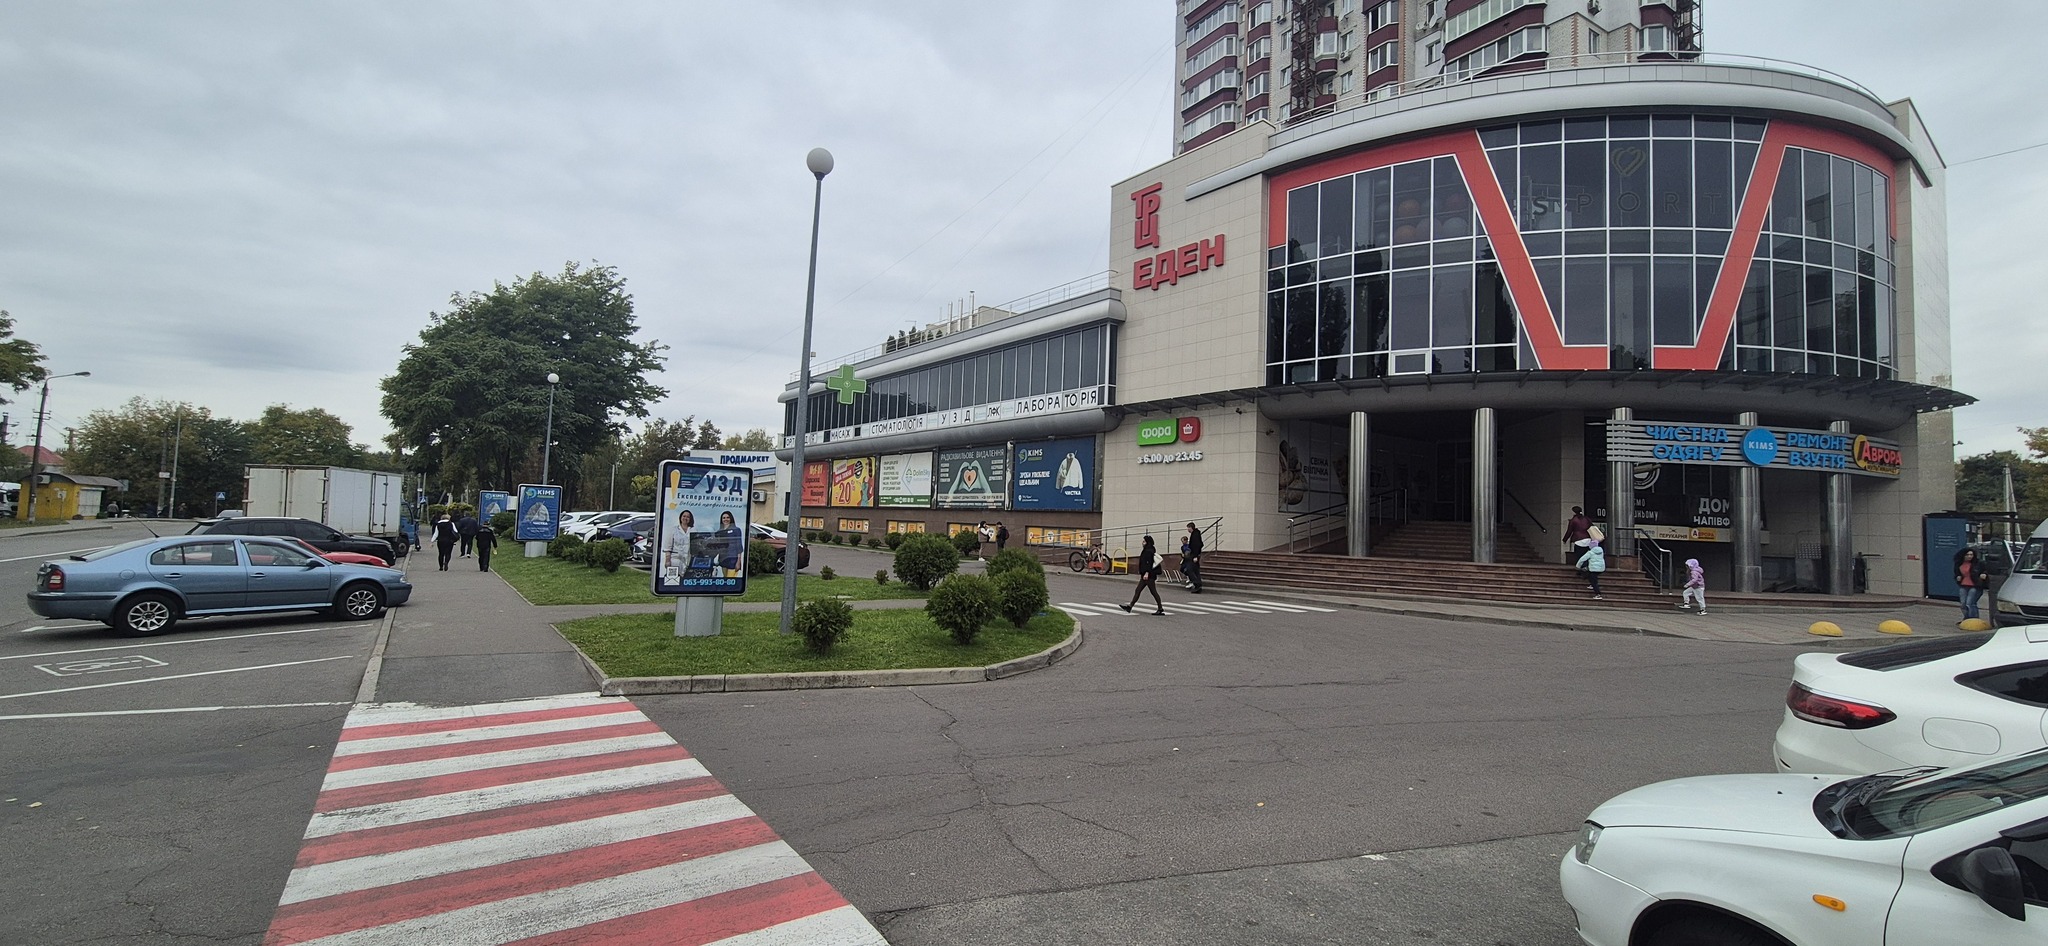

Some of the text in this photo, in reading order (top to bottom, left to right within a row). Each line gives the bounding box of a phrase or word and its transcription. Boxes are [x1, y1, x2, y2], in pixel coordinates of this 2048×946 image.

[1134, 234, 1225, 290] ЕДЕН
[831, 428, 851, 439] МАСАЖ
[871, 417, 923, 434] СТОМАТОЛОГІЯ
[987, 405, 1001, 418] ЛФК
[1645, 425, 1849, 450] ЧИСТКА РЕМОНТ
[1028, 448, 1043, 456] KIMS
[1748, 441, 1774, 450] KIMS
[720, 455, 770, 465] ПРОДМАРКЕТ
[1144, 452, 1162, 463] 6.00
[1163, 454, 1176, 464] до
[1176, 450, 1203, 462] 23.45
[1310, 457, 1329, 467] СВІЖА
[1653, 444, 1847, 469] ОДЯГУ ВЗУТТЯ
[1304, 465, 1329, 476] ВИПІЧКА
[705, 474, 743, 496] УЗД
